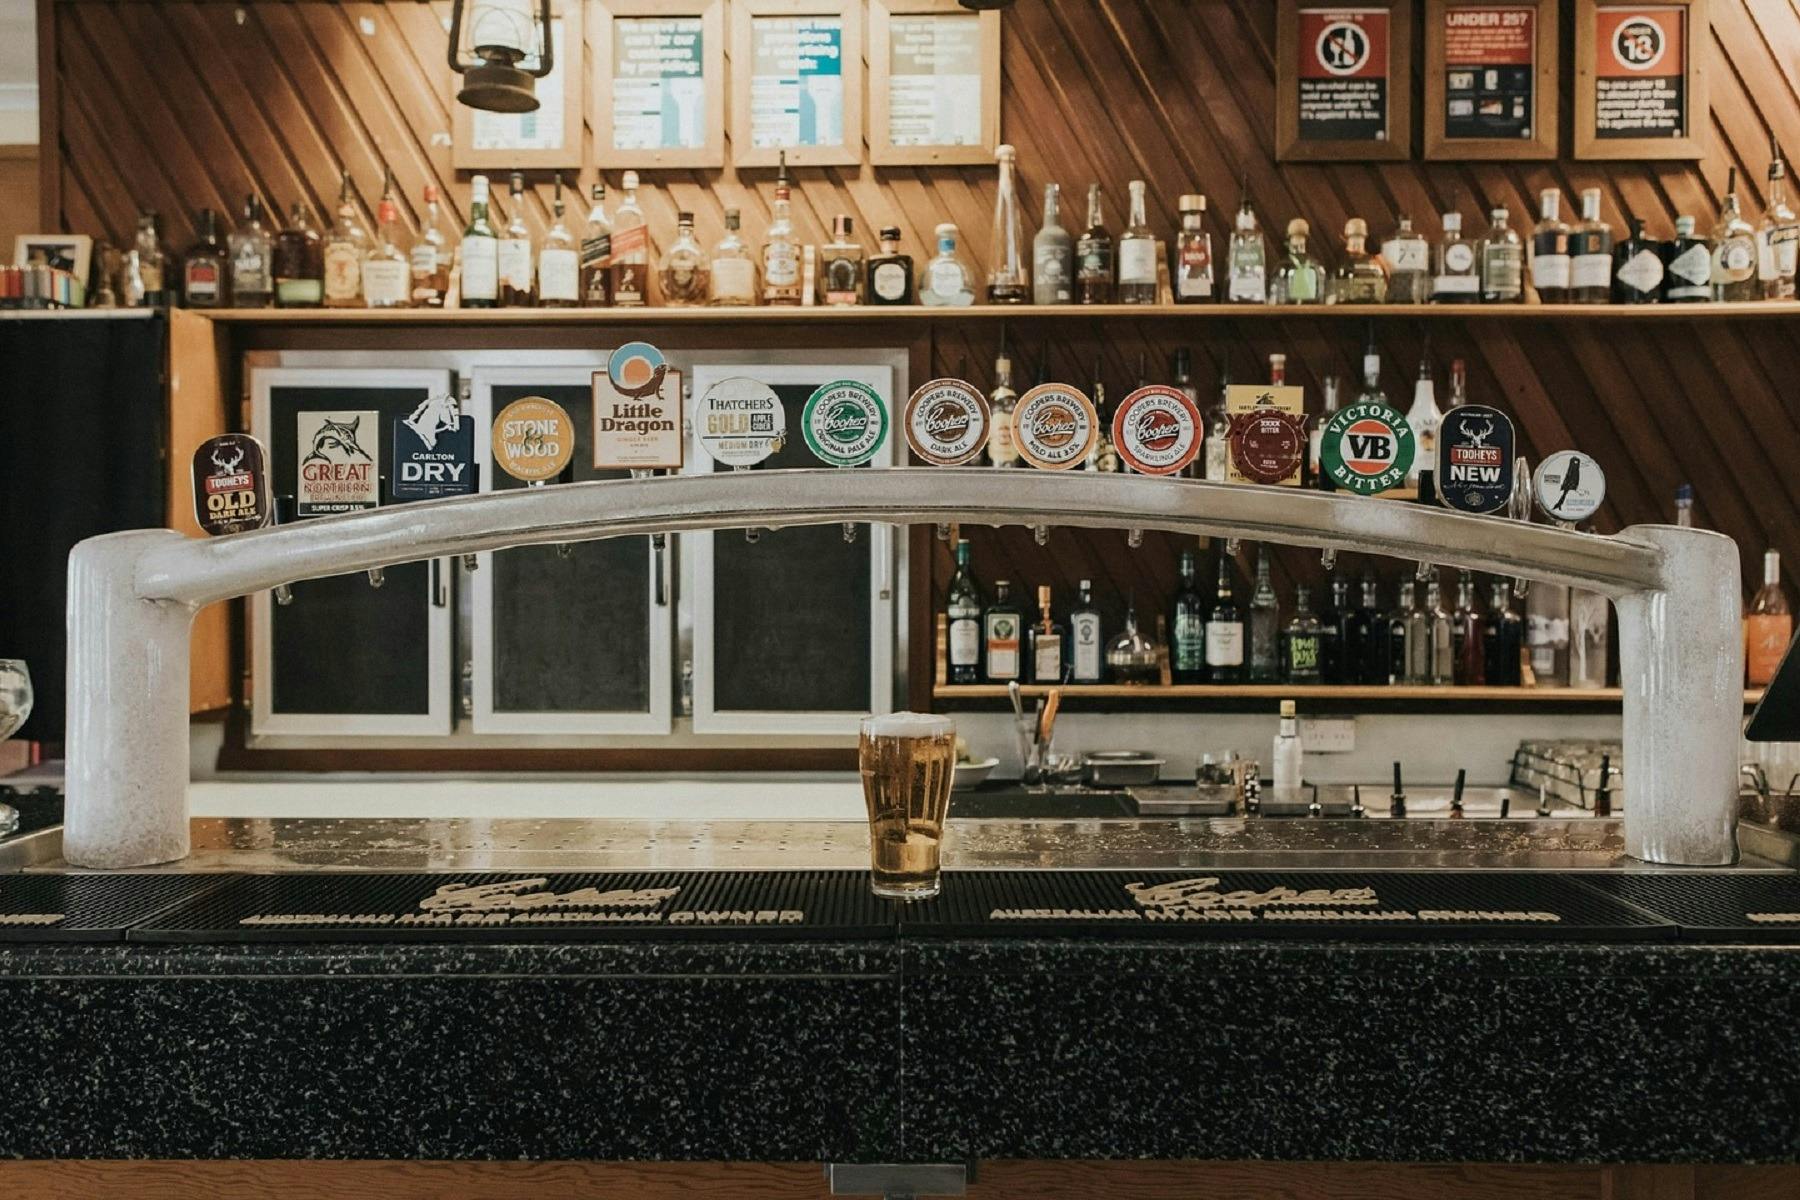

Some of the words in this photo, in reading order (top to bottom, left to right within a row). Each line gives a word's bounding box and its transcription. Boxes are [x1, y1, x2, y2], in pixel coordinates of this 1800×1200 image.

[1447, 13, 1499, 26] UNDER
[1623, 35, 1655, 60] 18
[612, 403, 663, 418] Little
[708, 397, 773, 410] THATCHERS
[816, 391, 846, 415] COOPERS
[849, 391, 877, 416] BREWERY
[917, 390, 945, 417] COOPERS
[947, 390, 978, 414] BREWERY
[1025, 395, 1054, 420] COOPERS
[1057, 395, 1086, 421] BREWERY
[1128, 399, 1155, 426] COOPERS
[1157, 399, 1188, 422] BREWERY
[503, 419, 559, 438] STONE
[601, 418, 674, 435] Dragon
[708, 413, 749, 433] GOLD
[1330, 405, 1409, 438] VICTORIA
[503, 441, 559, 460] WOOD
[718, 441, 747, 449] MEDIUM
[816, 429, 845, 453] ORIGINAL
[848, 442, 866, 454] PALE
[865, 430, 876, 444] ALE
[930, 443, 952, 454] DARK
[954, 441, 968, 452] ALE
[1029, 441, 1046, 456] MILD
[1047, 451, 1062, 459] ALE
[1347, 435, 1391, 460] VB
[412, 453, 455, 461] CARLTON
[1133, 445, 1174, 462] SPARKLING
[1174, 444, 1186, 455] ALE
[1456, 449, 1497, 461] TOOHEYS
[303, 463, 370, 481] GREAT
[401, 462, 466, 482] DRY
[1334, 465, 1403, 490] BITTER
[1450, 465, 1501, 482] NEW
[209, 475, 249, 488] TOOHEYS
[304, 482, 370, 493] NORTHERN
[207, 490, 256, 511] OLD
